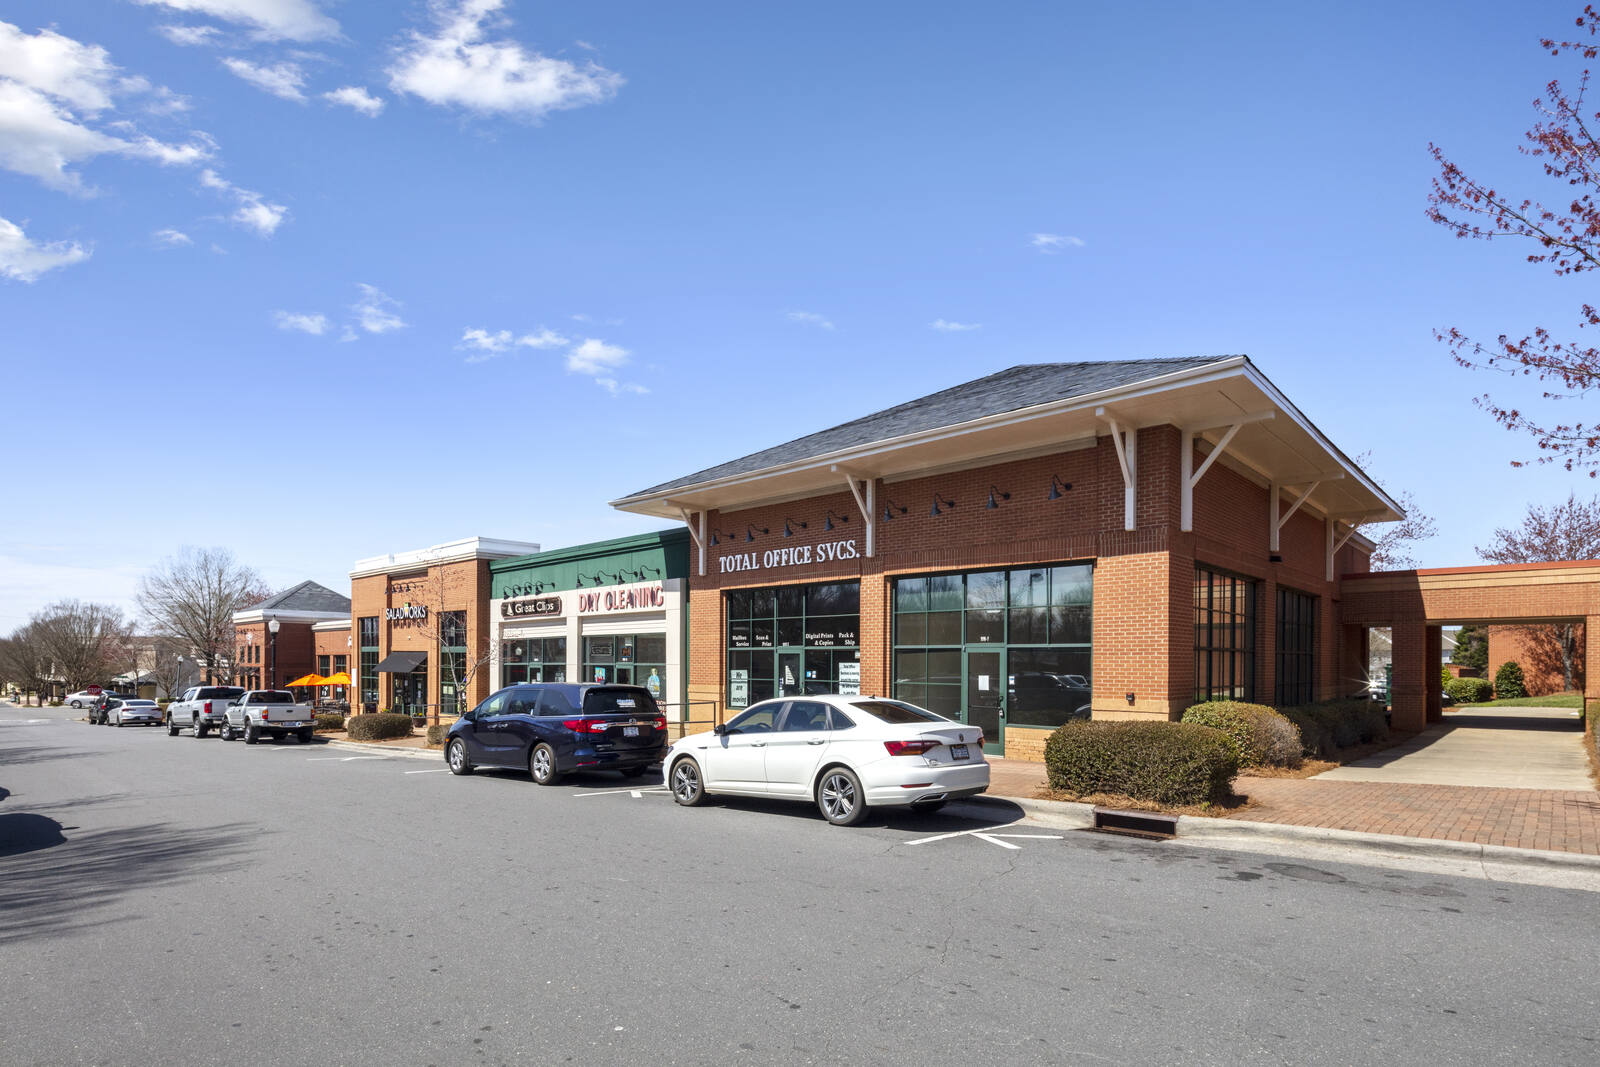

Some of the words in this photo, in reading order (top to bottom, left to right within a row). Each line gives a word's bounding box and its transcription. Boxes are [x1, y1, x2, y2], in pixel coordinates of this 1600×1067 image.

[719, 552, 760, 573] TOTAL
[763, 545, 812, 569] OFFICE
[816, 539, 861, 562] SVCS.
[514, 602, 535, 614] Great
[536, 600, 554, 613] Clips
[578, 592, 601, 612] DRY
[605, 586, 664, 611] CLEANING
[385, 605, 426, 620] SALADWORKS
